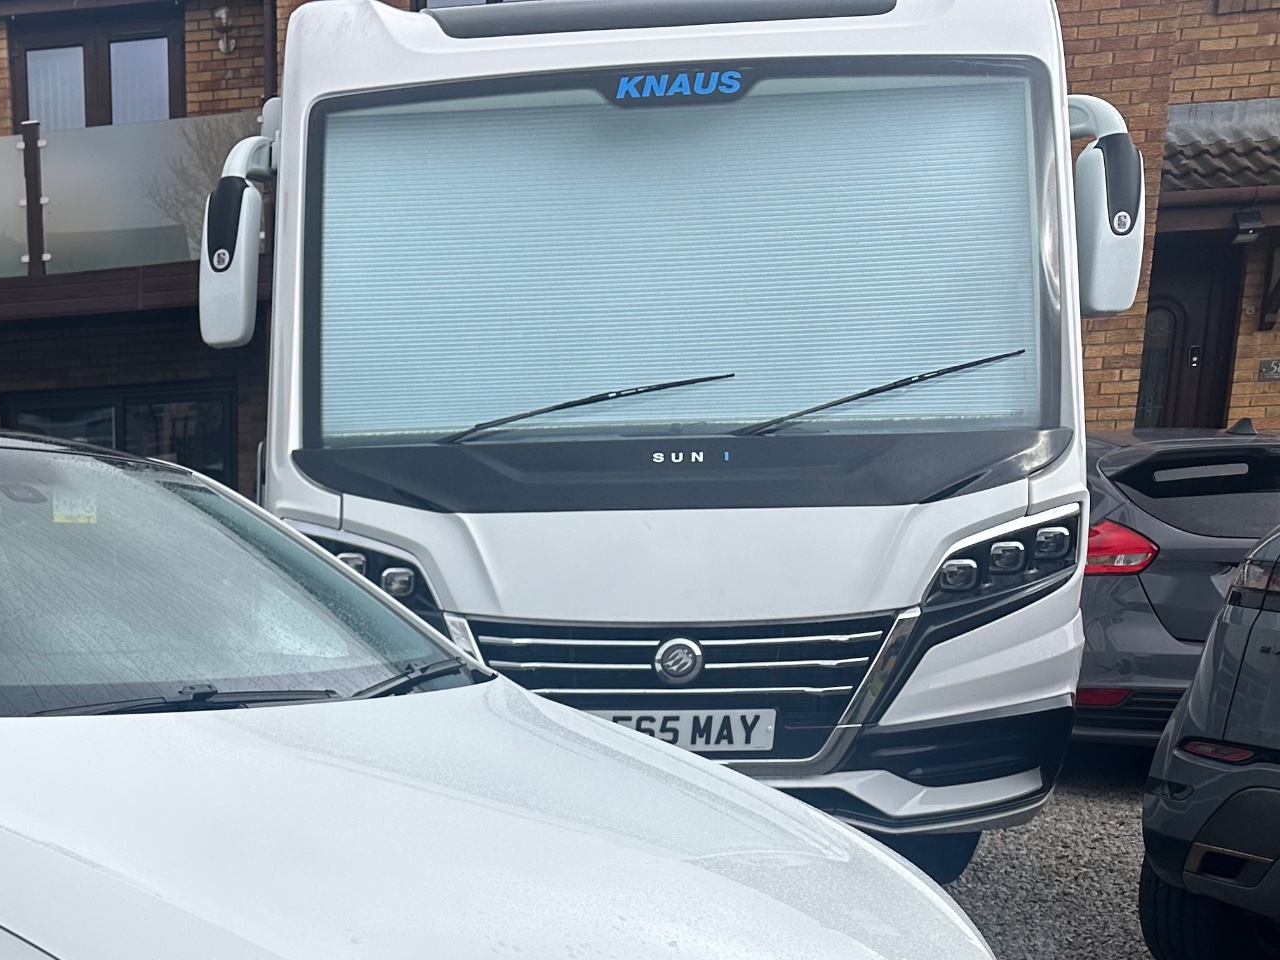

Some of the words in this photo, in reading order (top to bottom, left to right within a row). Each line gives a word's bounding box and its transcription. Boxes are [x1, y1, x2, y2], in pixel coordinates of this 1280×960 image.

[616, 71, 742, 99] KNAUS
[652, 451, 704, 463] SUN
[690, 714, 761, 745] MAY
